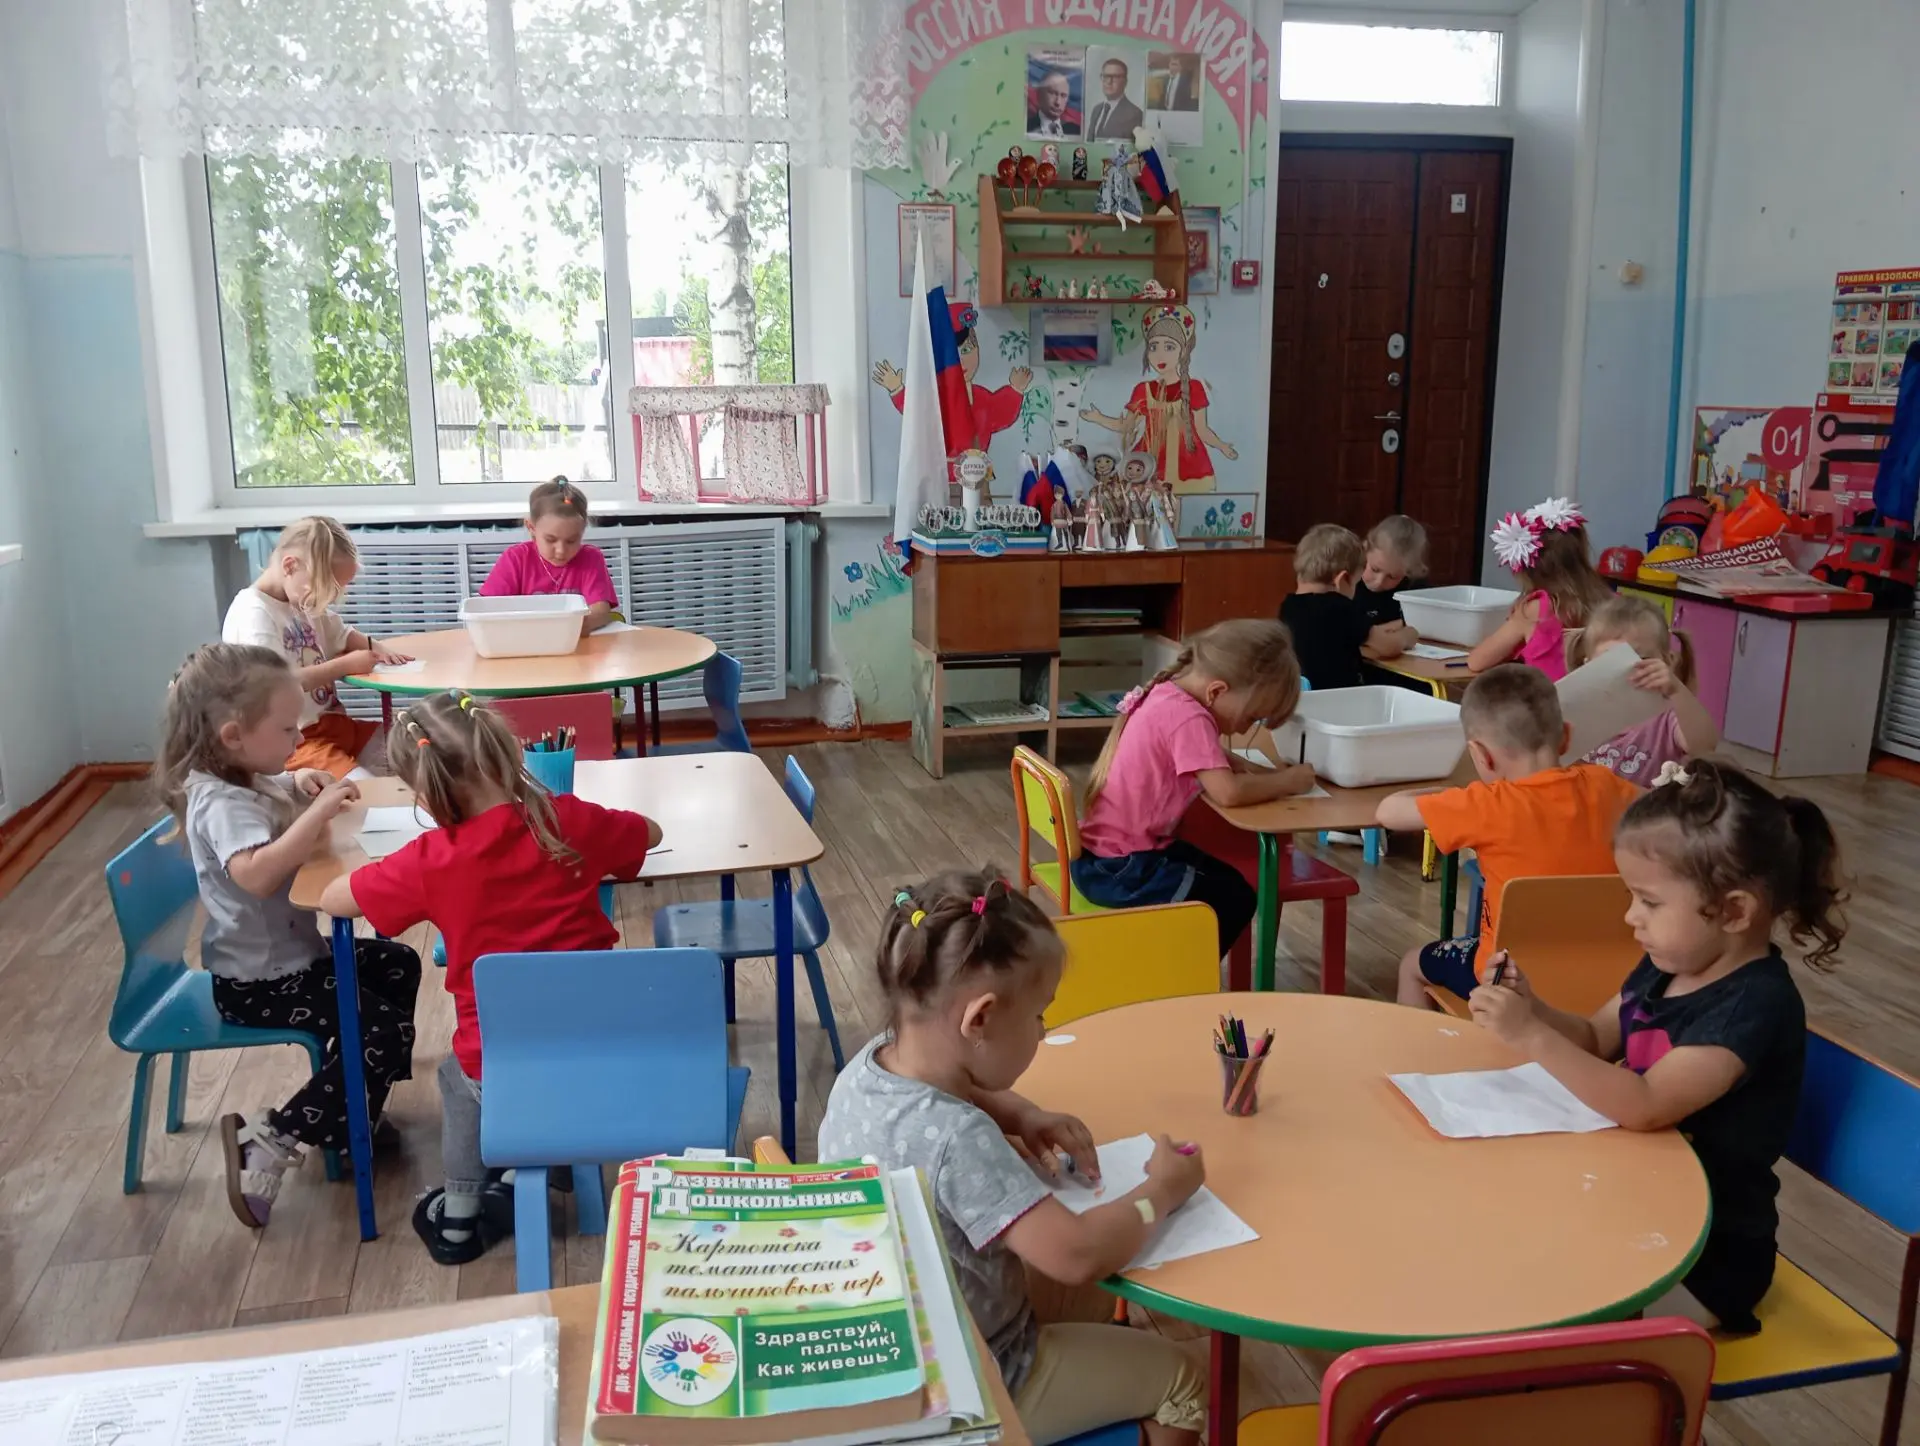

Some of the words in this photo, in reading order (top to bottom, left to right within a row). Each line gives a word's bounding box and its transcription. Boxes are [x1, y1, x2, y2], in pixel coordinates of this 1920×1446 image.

[1838, 273, 1875, 284] ПРАВИЛА
[1875, 270, 1920, 282] БЕЗОПАСН
[1772, 424, 1803, 457] 01
[1702, 536, 1777, 562] ПОЖАРНОЙ
[664, 1232, 822, 1263] Картотека
[623, 1239, 641, 1307] ГОСУДАРСТВЕННЫЕ
[664, 1257, 860, 1277] тематических
[664, 1276, 835, 1299] пальчиковых
[842, 1270, 885, 1297] игр
[617, 1310, 635, 1370] ФЕДЕРАЛЬНЫЕ
[754, 1320, 888, 1347] Здравствуй,
[800, 1331, 897, 1357] пальчик!
[757, 1362, 795, 1378] Как
[801, 1346, 901, 1374] живешь?
